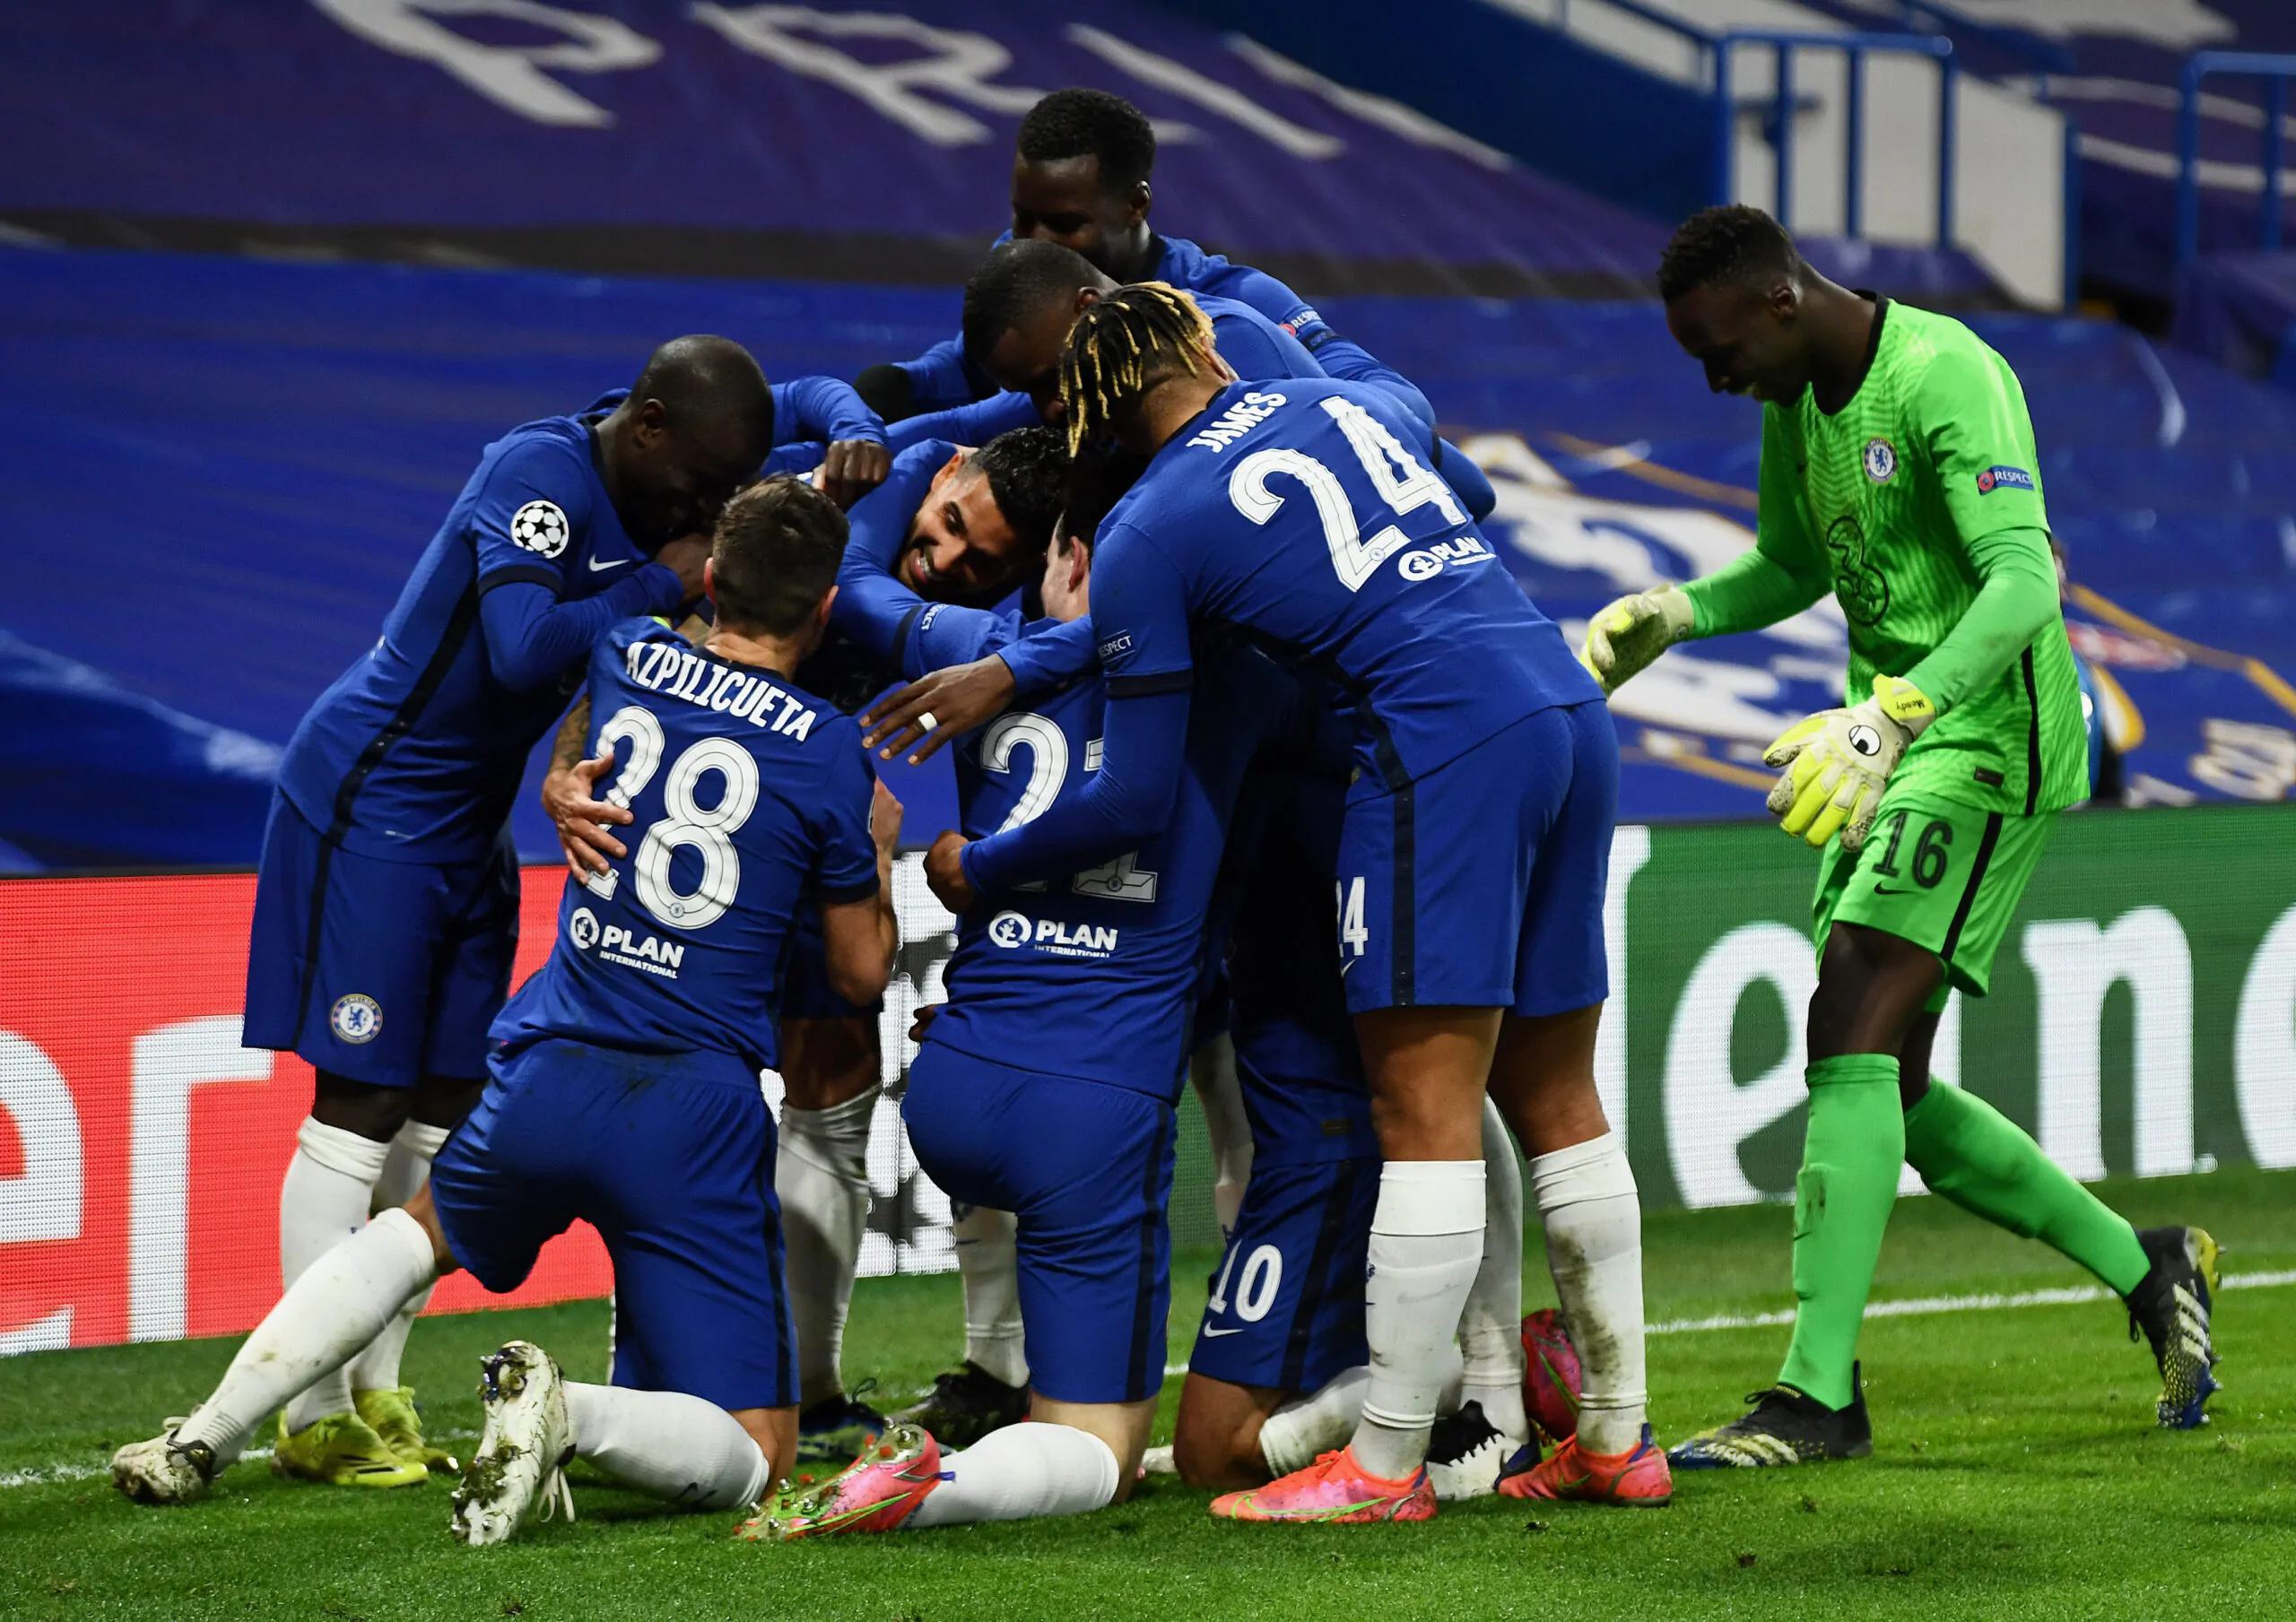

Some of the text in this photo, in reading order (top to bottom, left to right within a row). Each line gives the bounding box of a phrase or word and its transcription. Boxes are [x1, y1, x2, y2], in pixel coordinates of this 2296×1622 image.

[1187, 392, 1287, 453] JAMES
[1229, 395, 1466, 593] 24
[627, 641, 817, 742] AZPILICUETA
[587, 705, 761, 930] 28
[1871, 810, 1953, 889] 16
[600, 924, 685, 968] PLAN
[1035, 919, 1118, 951] PLAN
[1335, 876, 1369, 958] 4
[598, 950, 678, 979] INTERNATIONAL
[1208, 1238, 1283, 1323] 10
